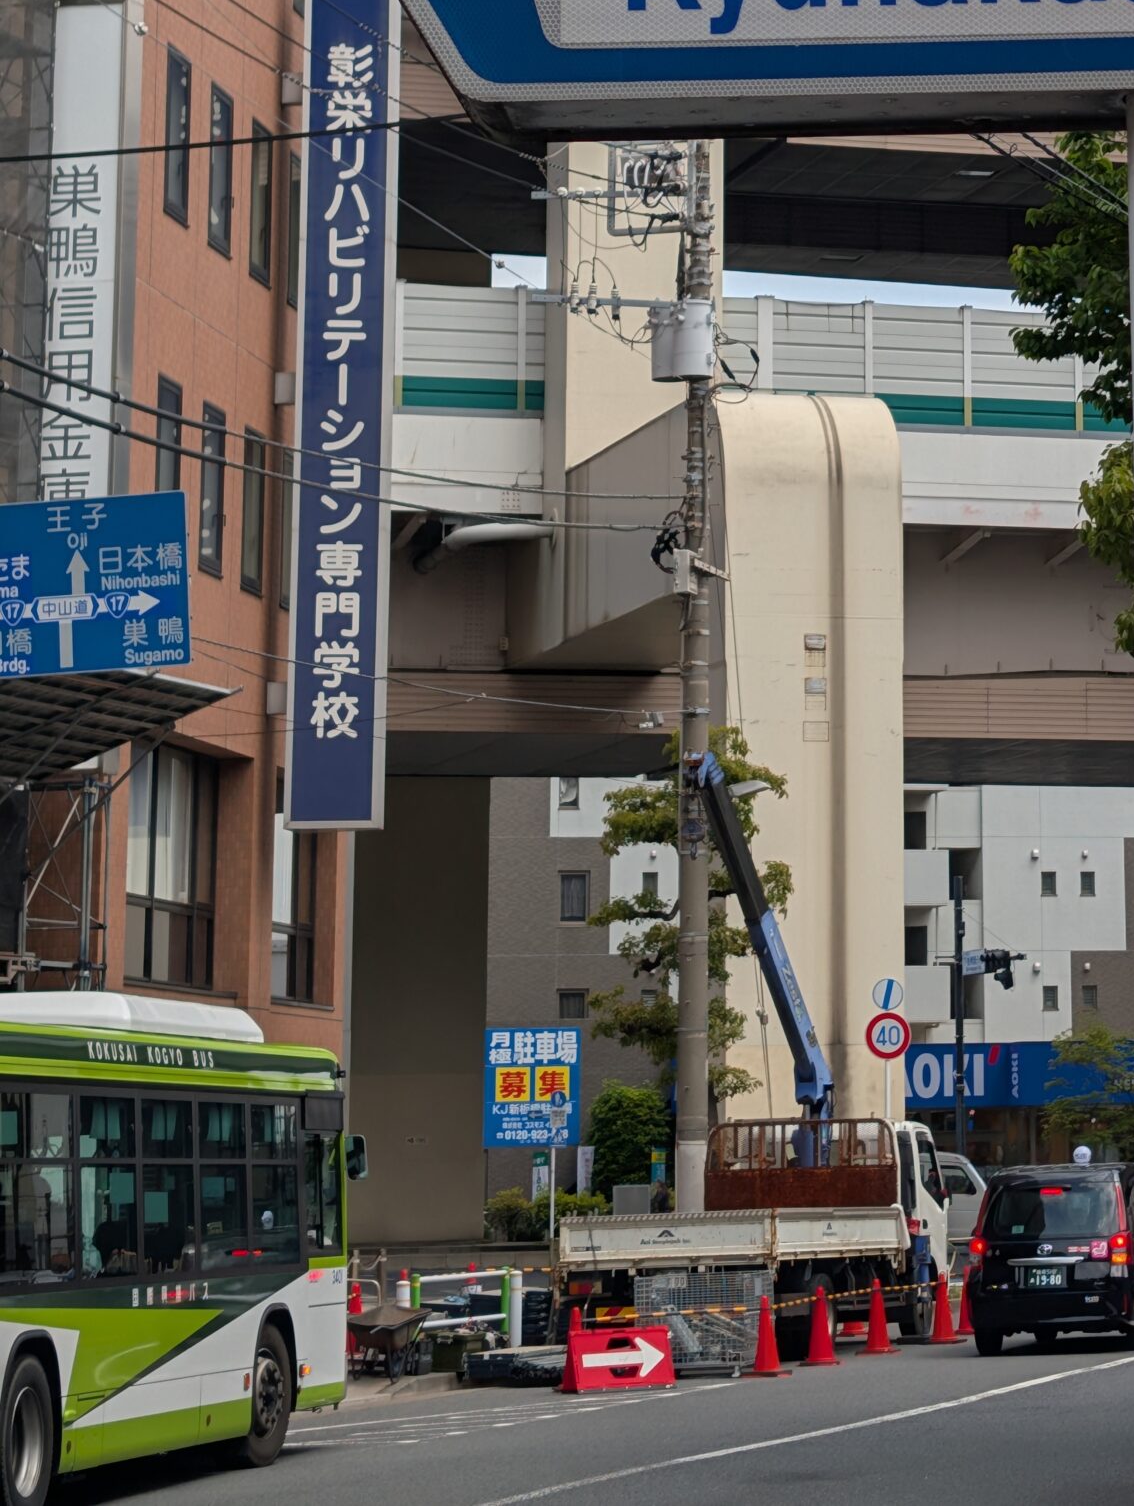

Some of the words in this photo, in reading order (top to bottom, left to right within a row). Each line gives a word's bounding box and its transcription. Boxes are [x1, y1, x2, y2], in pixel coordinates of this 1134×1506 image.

[310, 43, 374, 739] 彰栄リハビリテーション専門学校
[47, 502, 107, 533] 王子
[67, 533, 88, 551] Oji
[99, 542, 182, 574] 日本橋
[101, 570, 181, 591] Nihonbashi
[5, 602, 21, 616] 17
[42, 599, 89, 617] 中山道
[110, 596, 126, 611] 17
[0, 628, 33, 657] 橋
[123, 616, 184, 647] 巣鴨
[125, 647, 184, 665] Sugamo
[876, 1026, 901, 1046] 40
[87, 1041, 138, 1062] KOKUSAI
[147, 1046, 183, 1066] KOGYO
[192, 1050, 215, 1068] BUS
[500, 1070, 567, 1098] 募集
[1011, 1053, 1019, 1099] AOKI
[1036, 1274, 1062, 1286] 19-80
